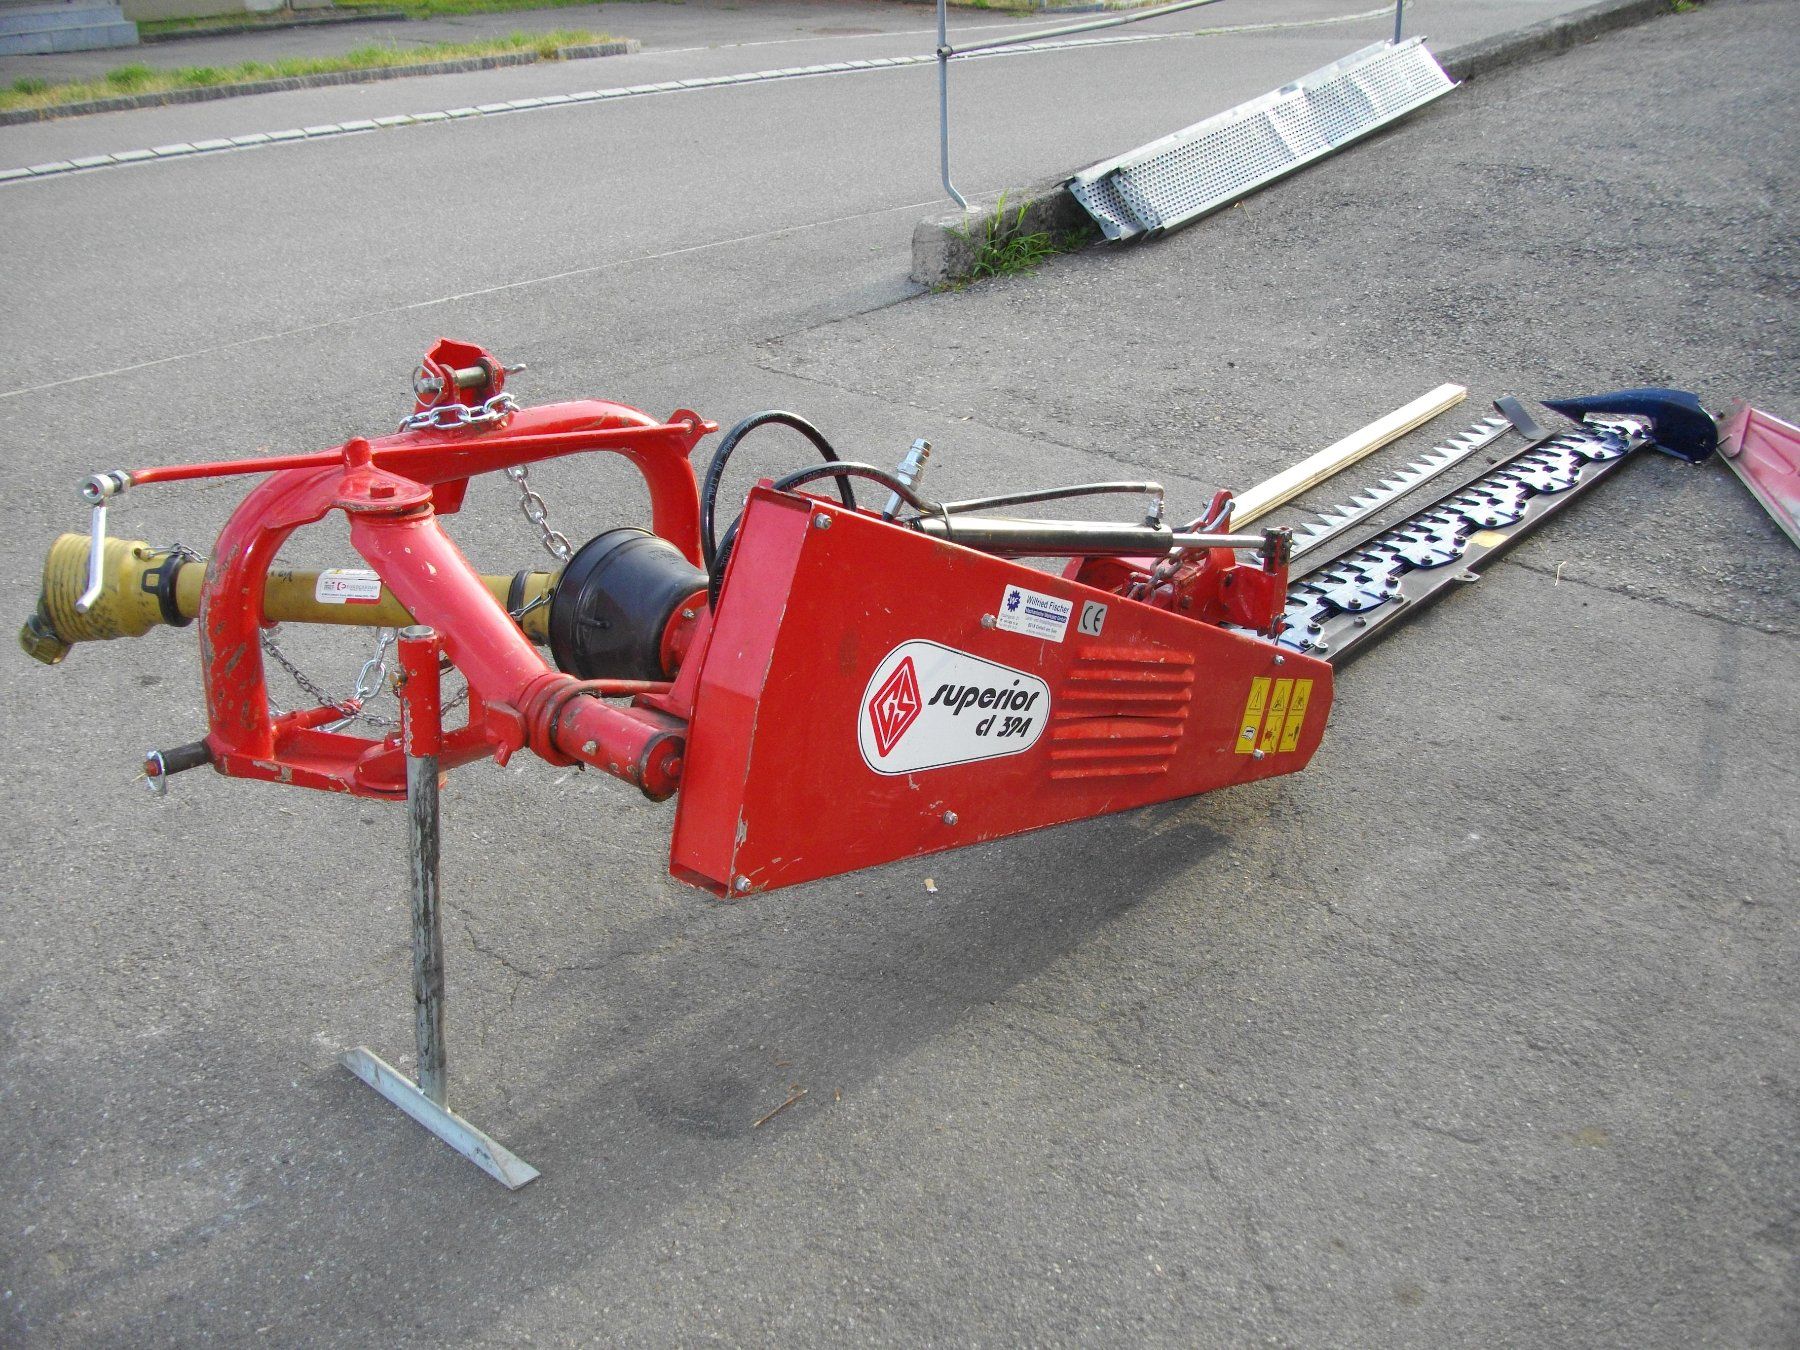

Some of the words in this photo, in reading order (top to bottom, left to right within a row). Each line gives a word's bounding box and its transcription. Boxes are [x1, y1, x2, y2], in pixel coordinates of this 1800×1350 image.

[1027, 595, 1049, 609] Wilfried
[1049, 601, 1070, 614] Fischer
[928, 679, 1040, 716] superior
